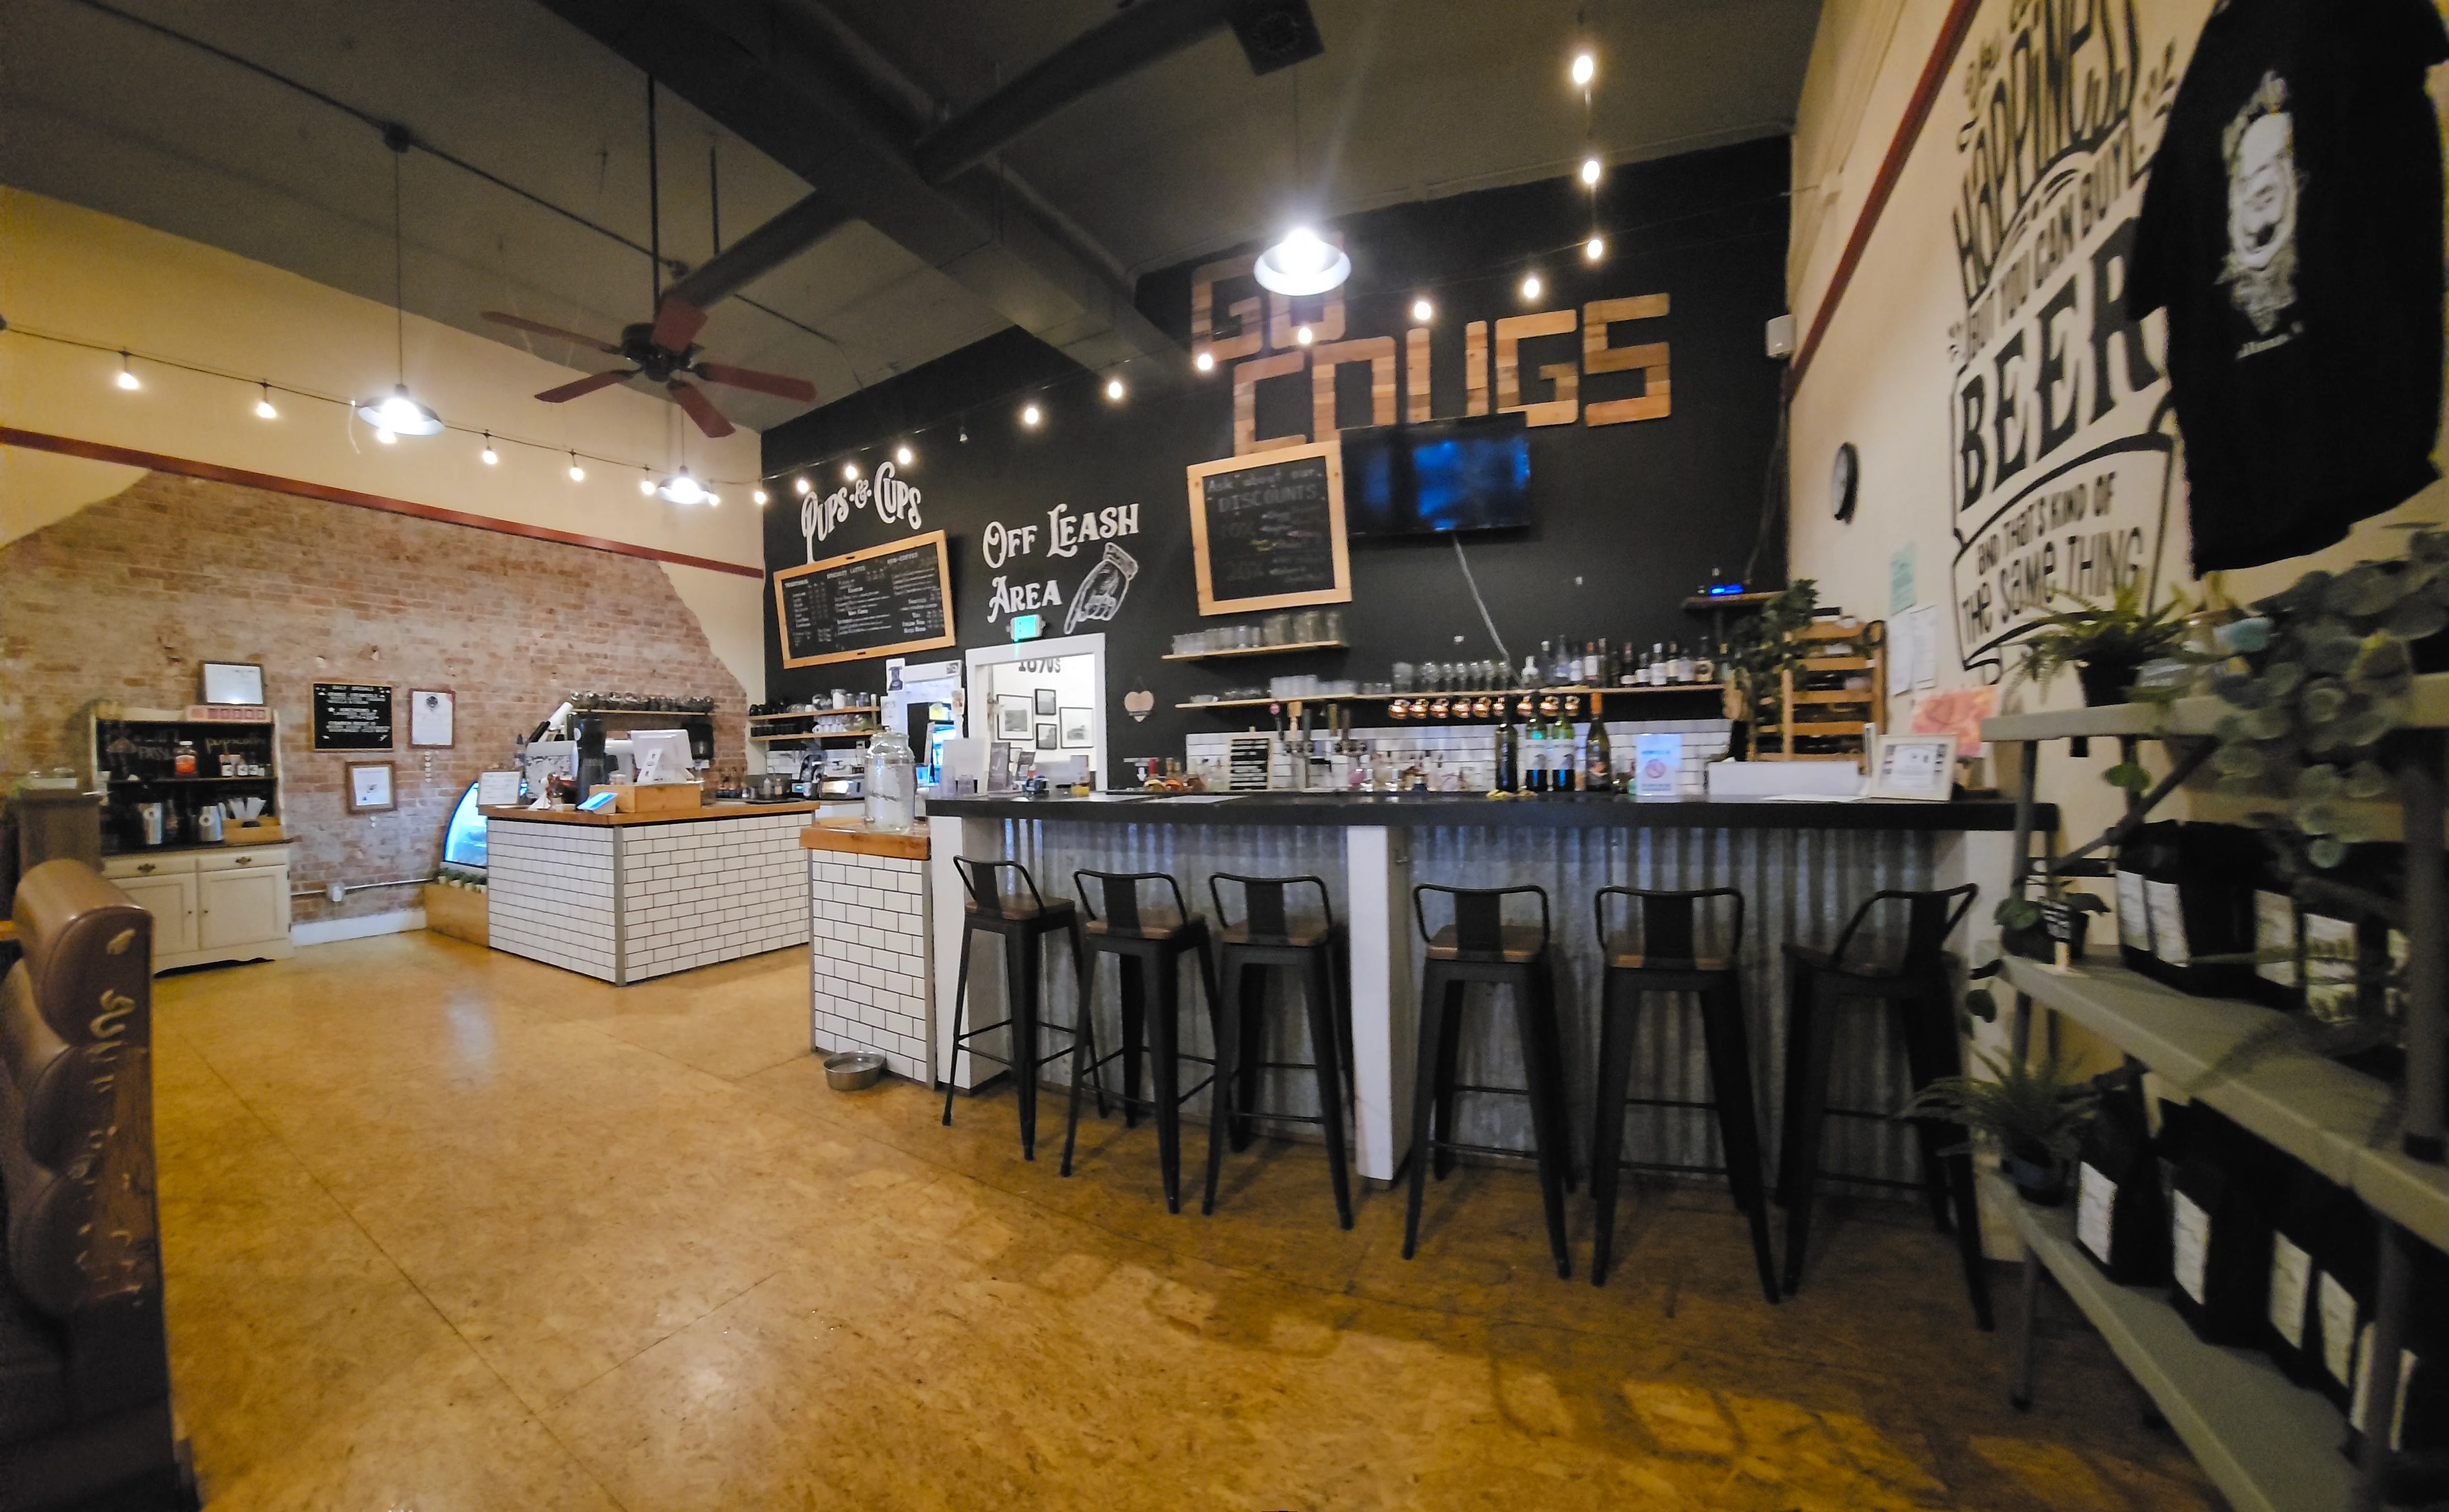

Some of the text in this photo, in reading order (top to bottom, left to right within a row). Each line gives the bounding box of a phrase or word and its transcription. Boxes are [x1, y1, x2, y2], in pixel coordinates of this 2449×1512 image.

[1234, 293, 1671, 457] COUGS
[1958, 217, 2167, 513] BEER
[801, 491, 850, 564] PUPS
[874, 461, 922, 530] CUPS
[982, 503, 1140, 569] OFF LEASH
[987, 575, 1062, 623] AREA
